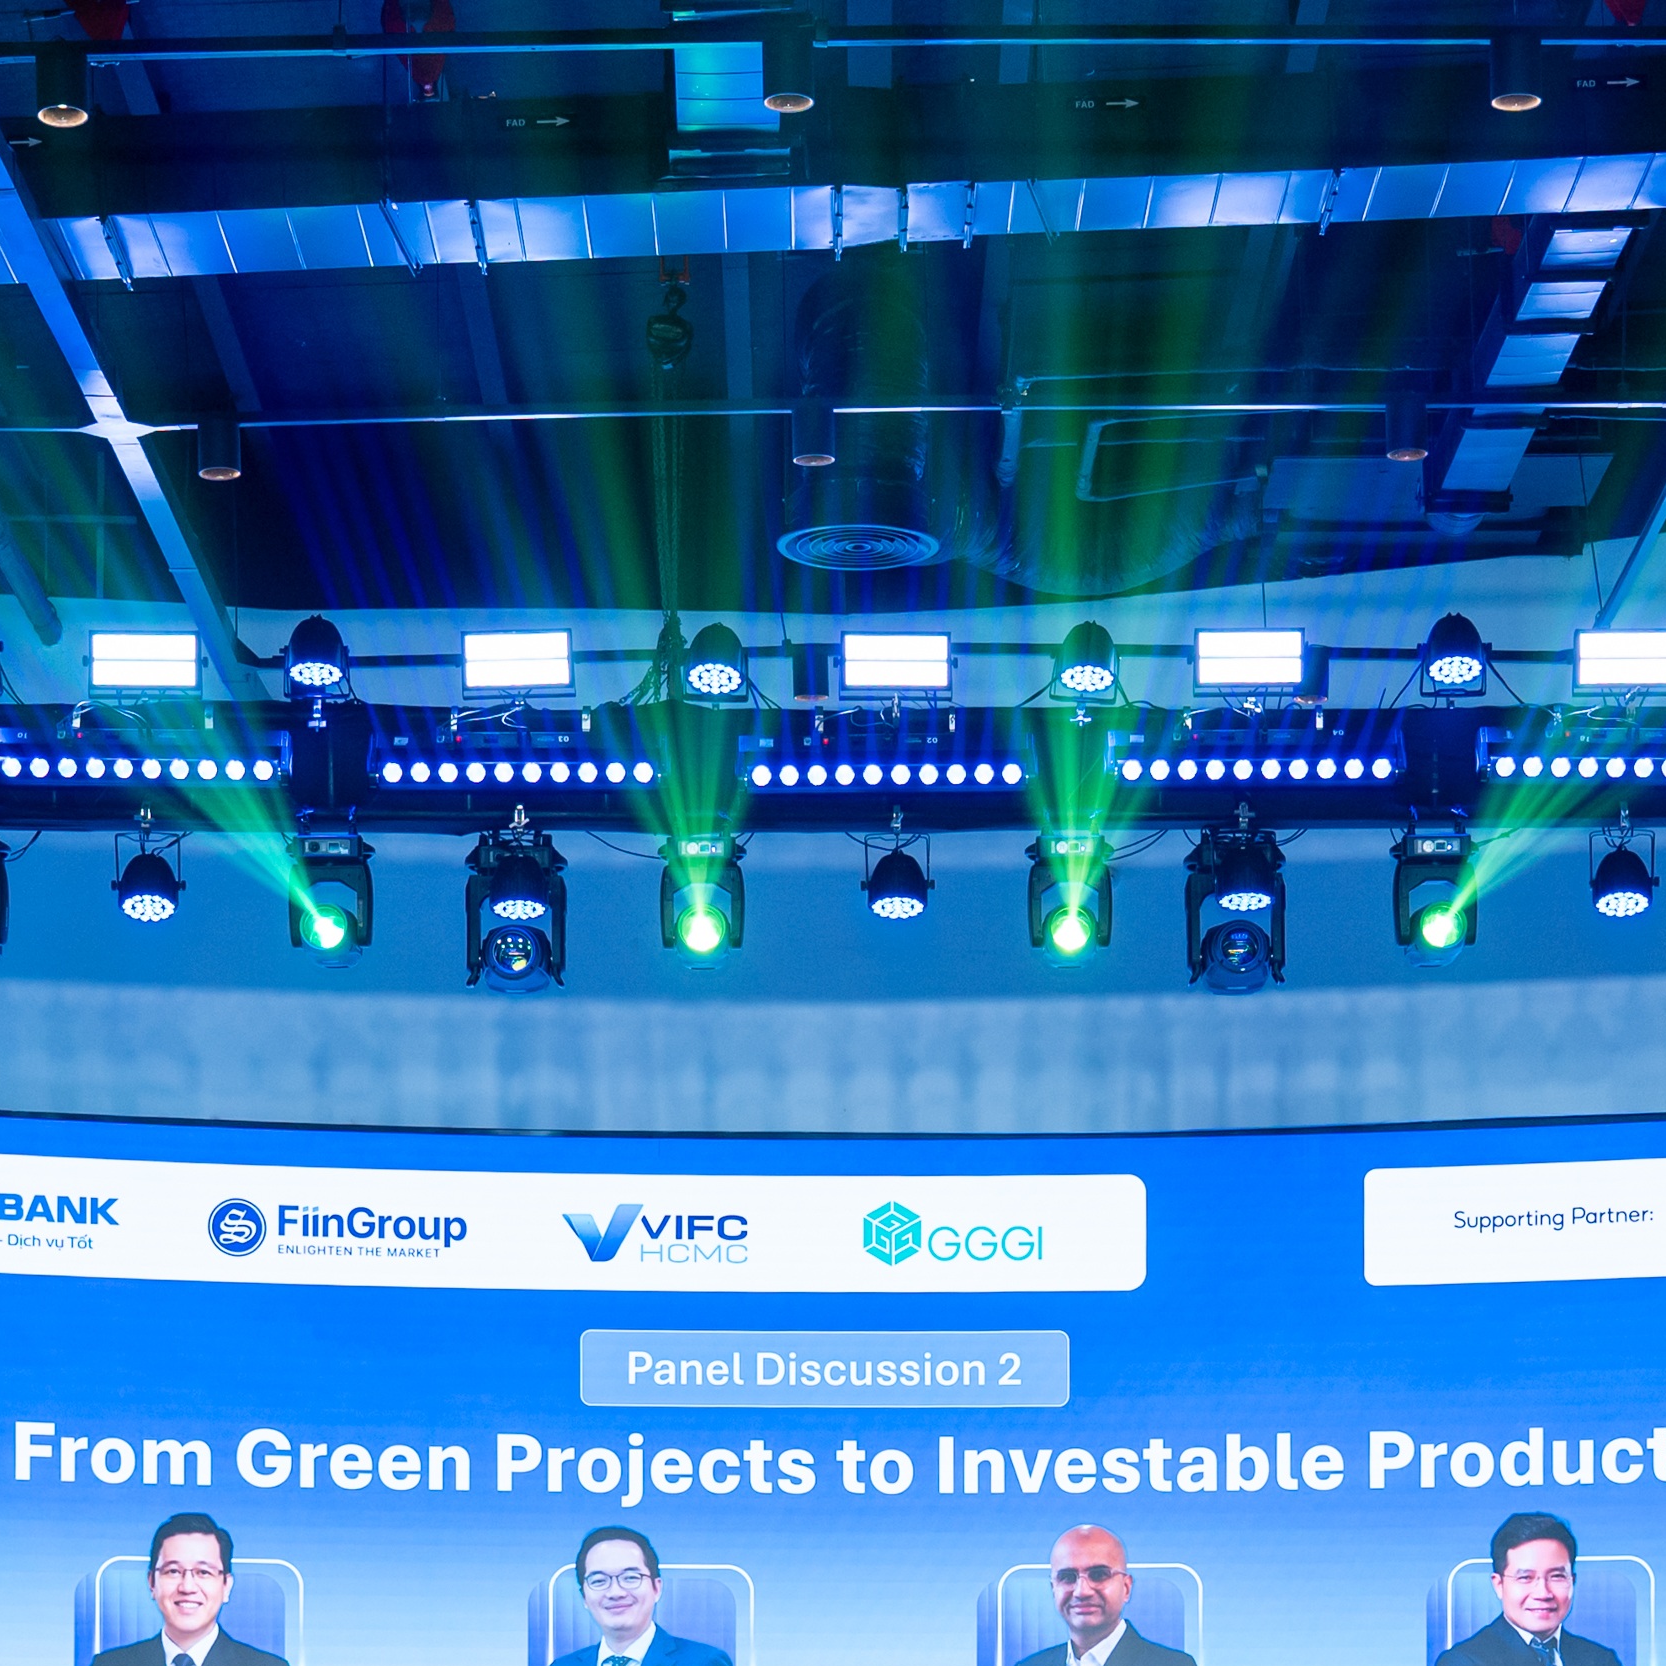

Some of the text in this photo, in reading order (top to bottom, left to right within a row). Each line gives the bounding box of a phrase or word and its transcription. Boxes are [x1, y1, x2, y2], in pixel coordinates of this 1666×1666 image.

[1577, 79, 1596, 88] FAD
[1075, 100, 1095, 109] FAD
[506, 118, 526, 128] FAD
[557, 735, 570, 743] 03
[278, 1205, 467, 1247] FiinGroup
[641, 1213, 748, 1241] VIFC
[1455, 1207, 1653, 1233] Supporting Partner:
[7, 1231, 43, 1252] Dịch
[45, 1235, 65, 1252] vụ
[67, 1231, 93, 1251] Tốt
[278, 1244, 441, 1259] ENLIGHTEN THE MARKET
[928, 1225, 1043, 1261] GGGI
[641, 1244, 748, 1264] HCMC
[627, 1350, 1023, 1387] Panel Discussion 2
[15, 1422, 211, 1485] From
[237, 1428, 470, 1490] Green
[497, 1433, 815, 1507] Projects
[836, 1440, 913, 1494] to
[939, 1433, 1344, 1493] Investable
